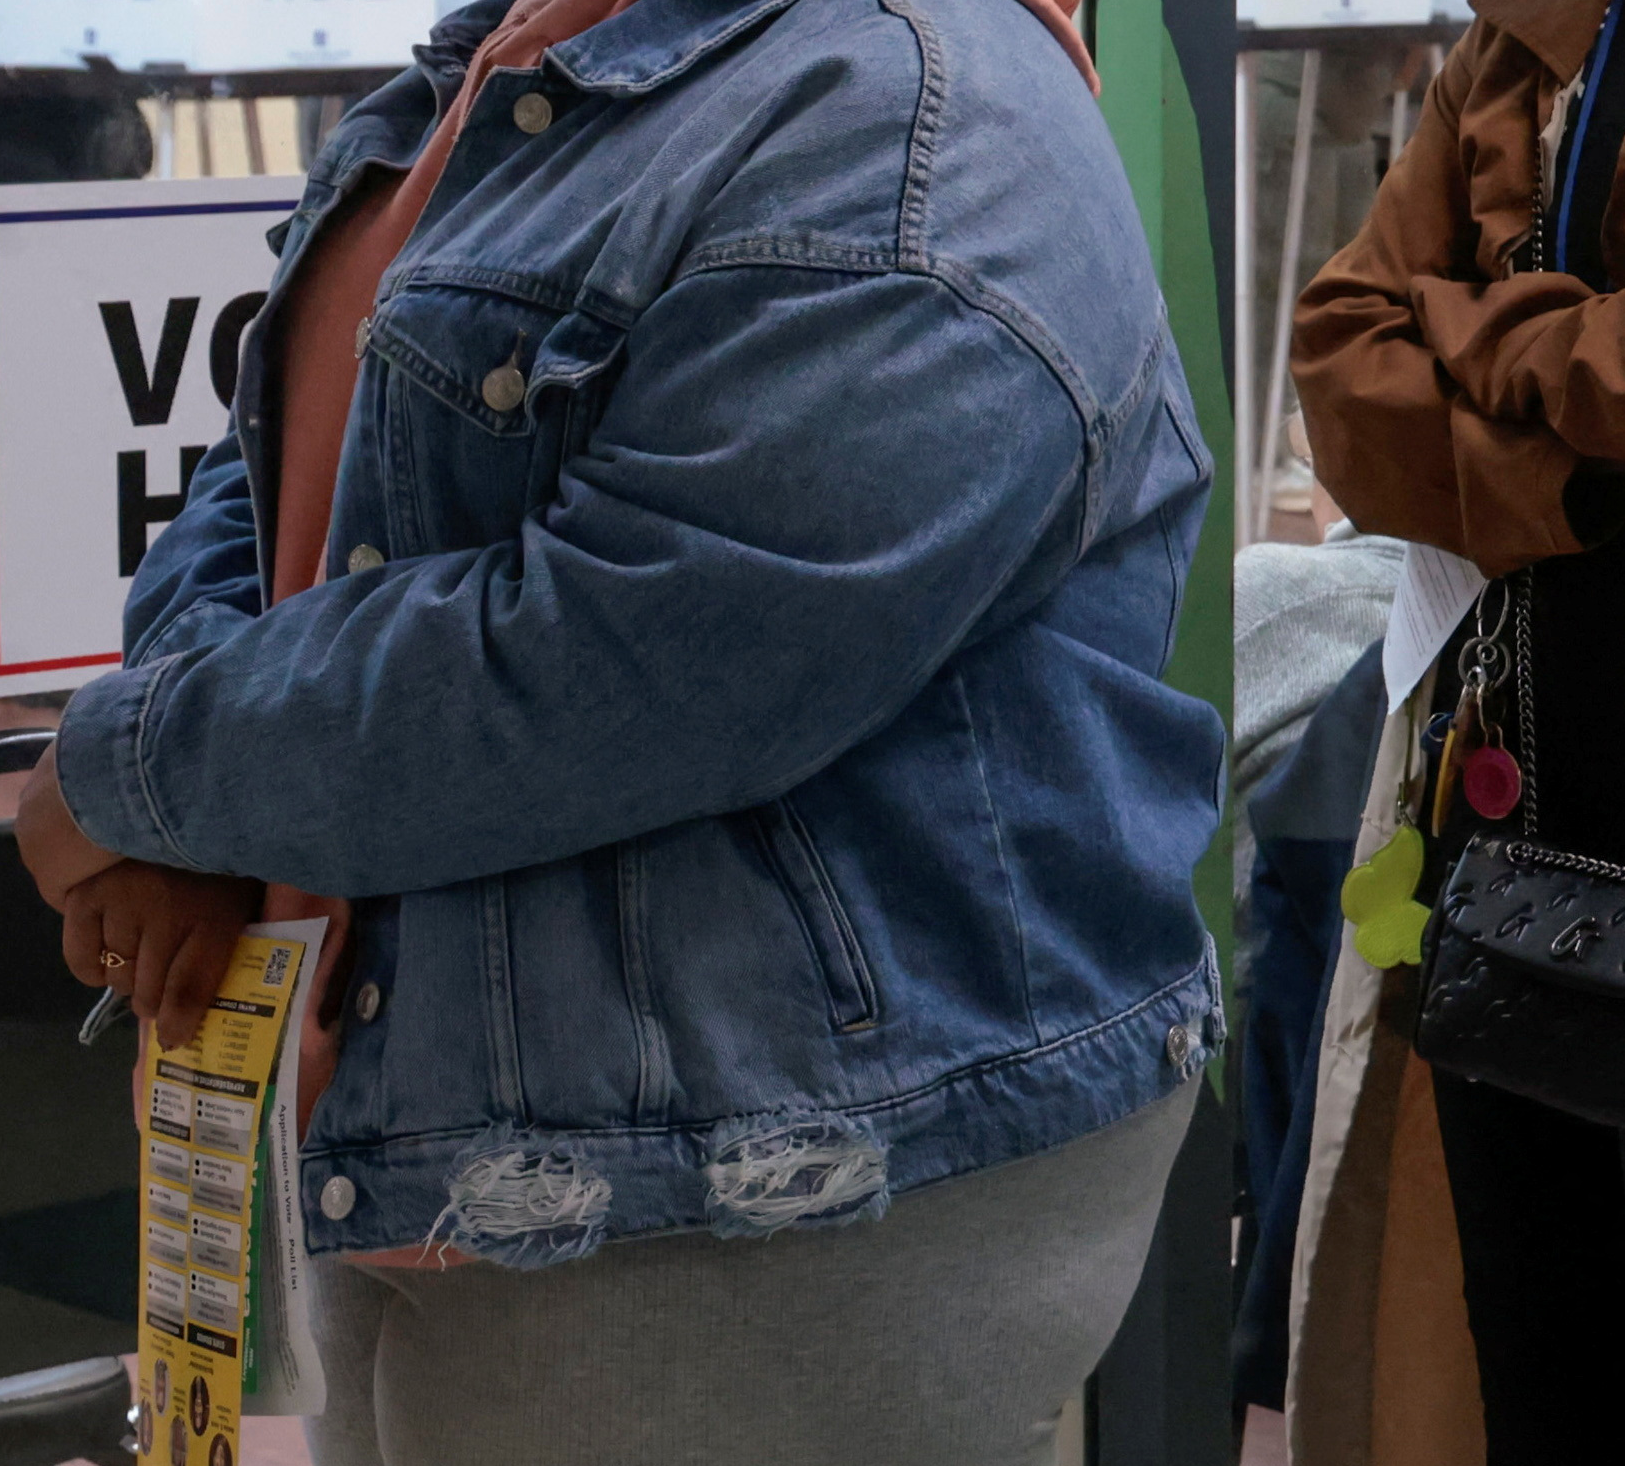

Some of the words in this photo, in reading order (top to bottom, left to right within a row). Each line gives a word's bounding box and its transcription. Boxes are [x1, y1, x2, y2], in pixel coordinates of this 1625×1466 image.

[277, 1104, 289, 1177] Application
[283, 1180, 290, 1193] to
[284, 1195, 292, 1224] Vote
[288, 1238, 297, 1264] Poll
[289, 1265, 298, 1291] List
